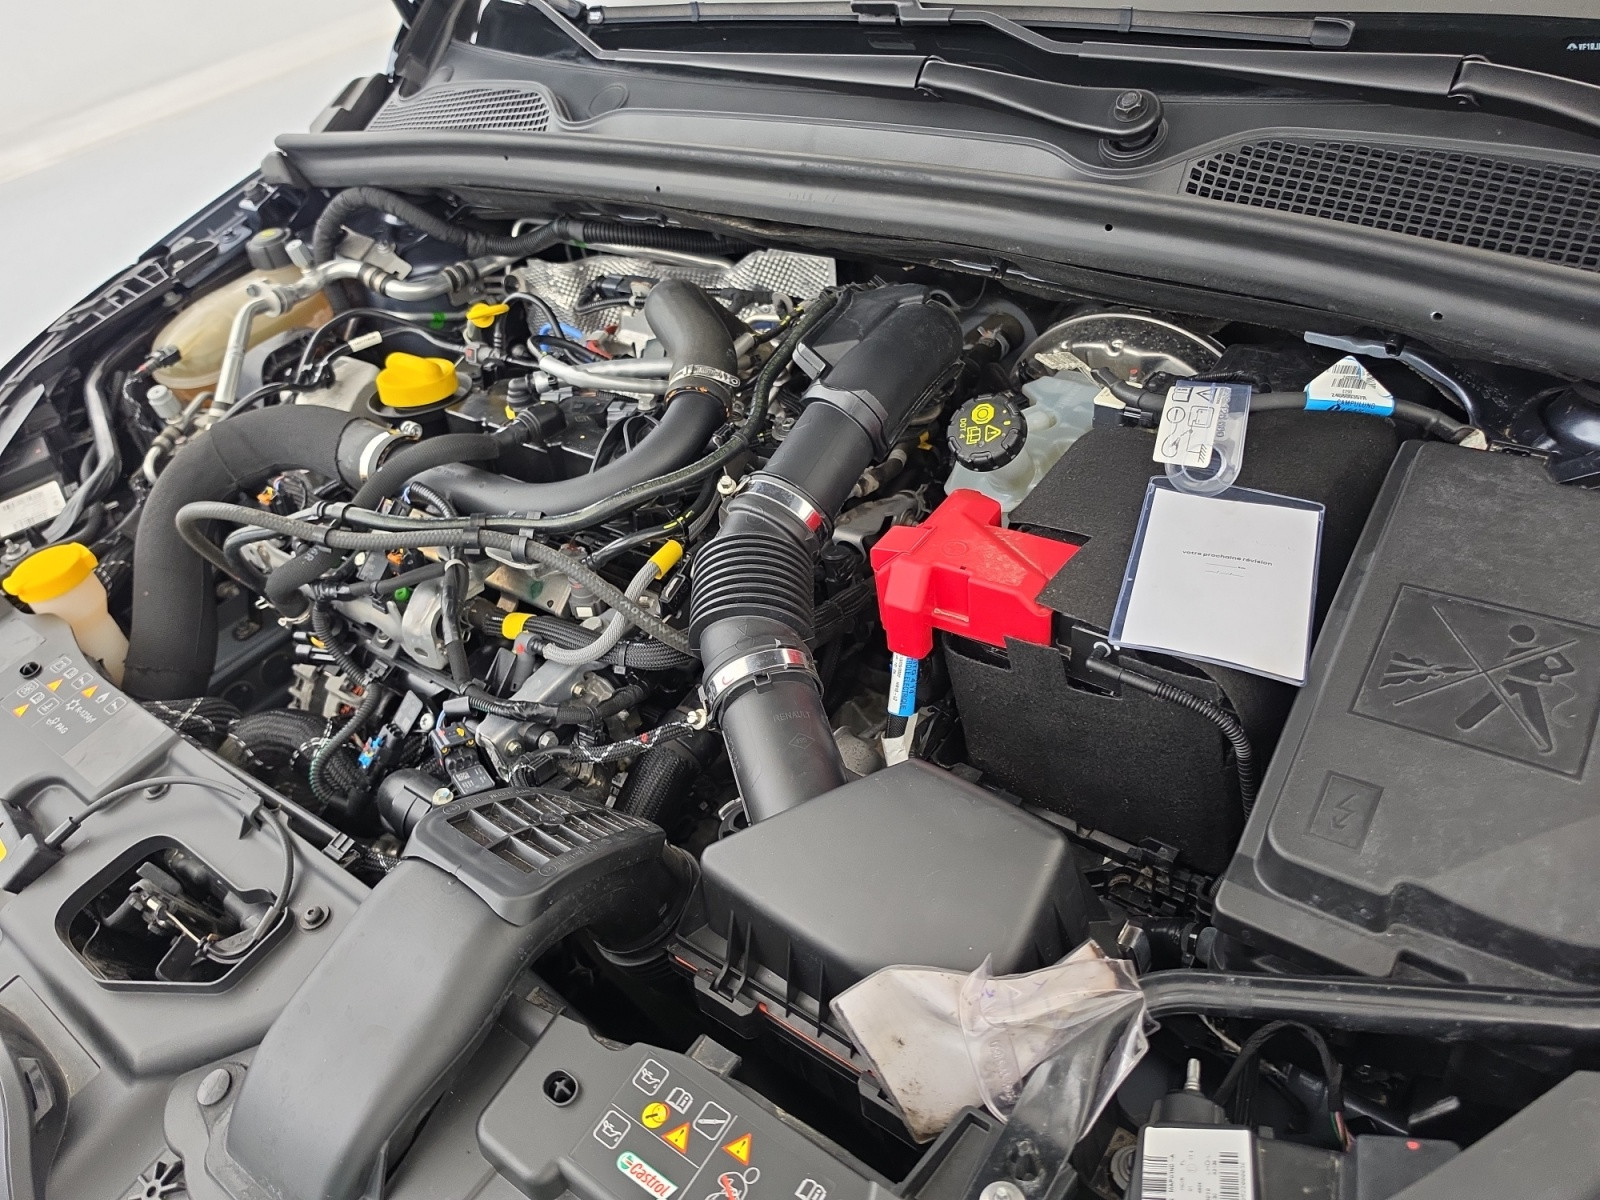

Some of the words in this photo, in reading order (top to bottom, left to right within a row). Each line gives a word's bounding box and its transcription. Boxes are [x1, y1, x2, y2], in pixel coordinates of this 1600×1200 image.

[959, 418, 967, 432] DOT
[1202, 553, 1241, 561] prochaine
[1242, 557, 1273, 566] révision
[773, 711, 811, 722] RENAULT
[54, 722, 69, 734] PAG
[629, 1162, 672, 1195] Castrol
